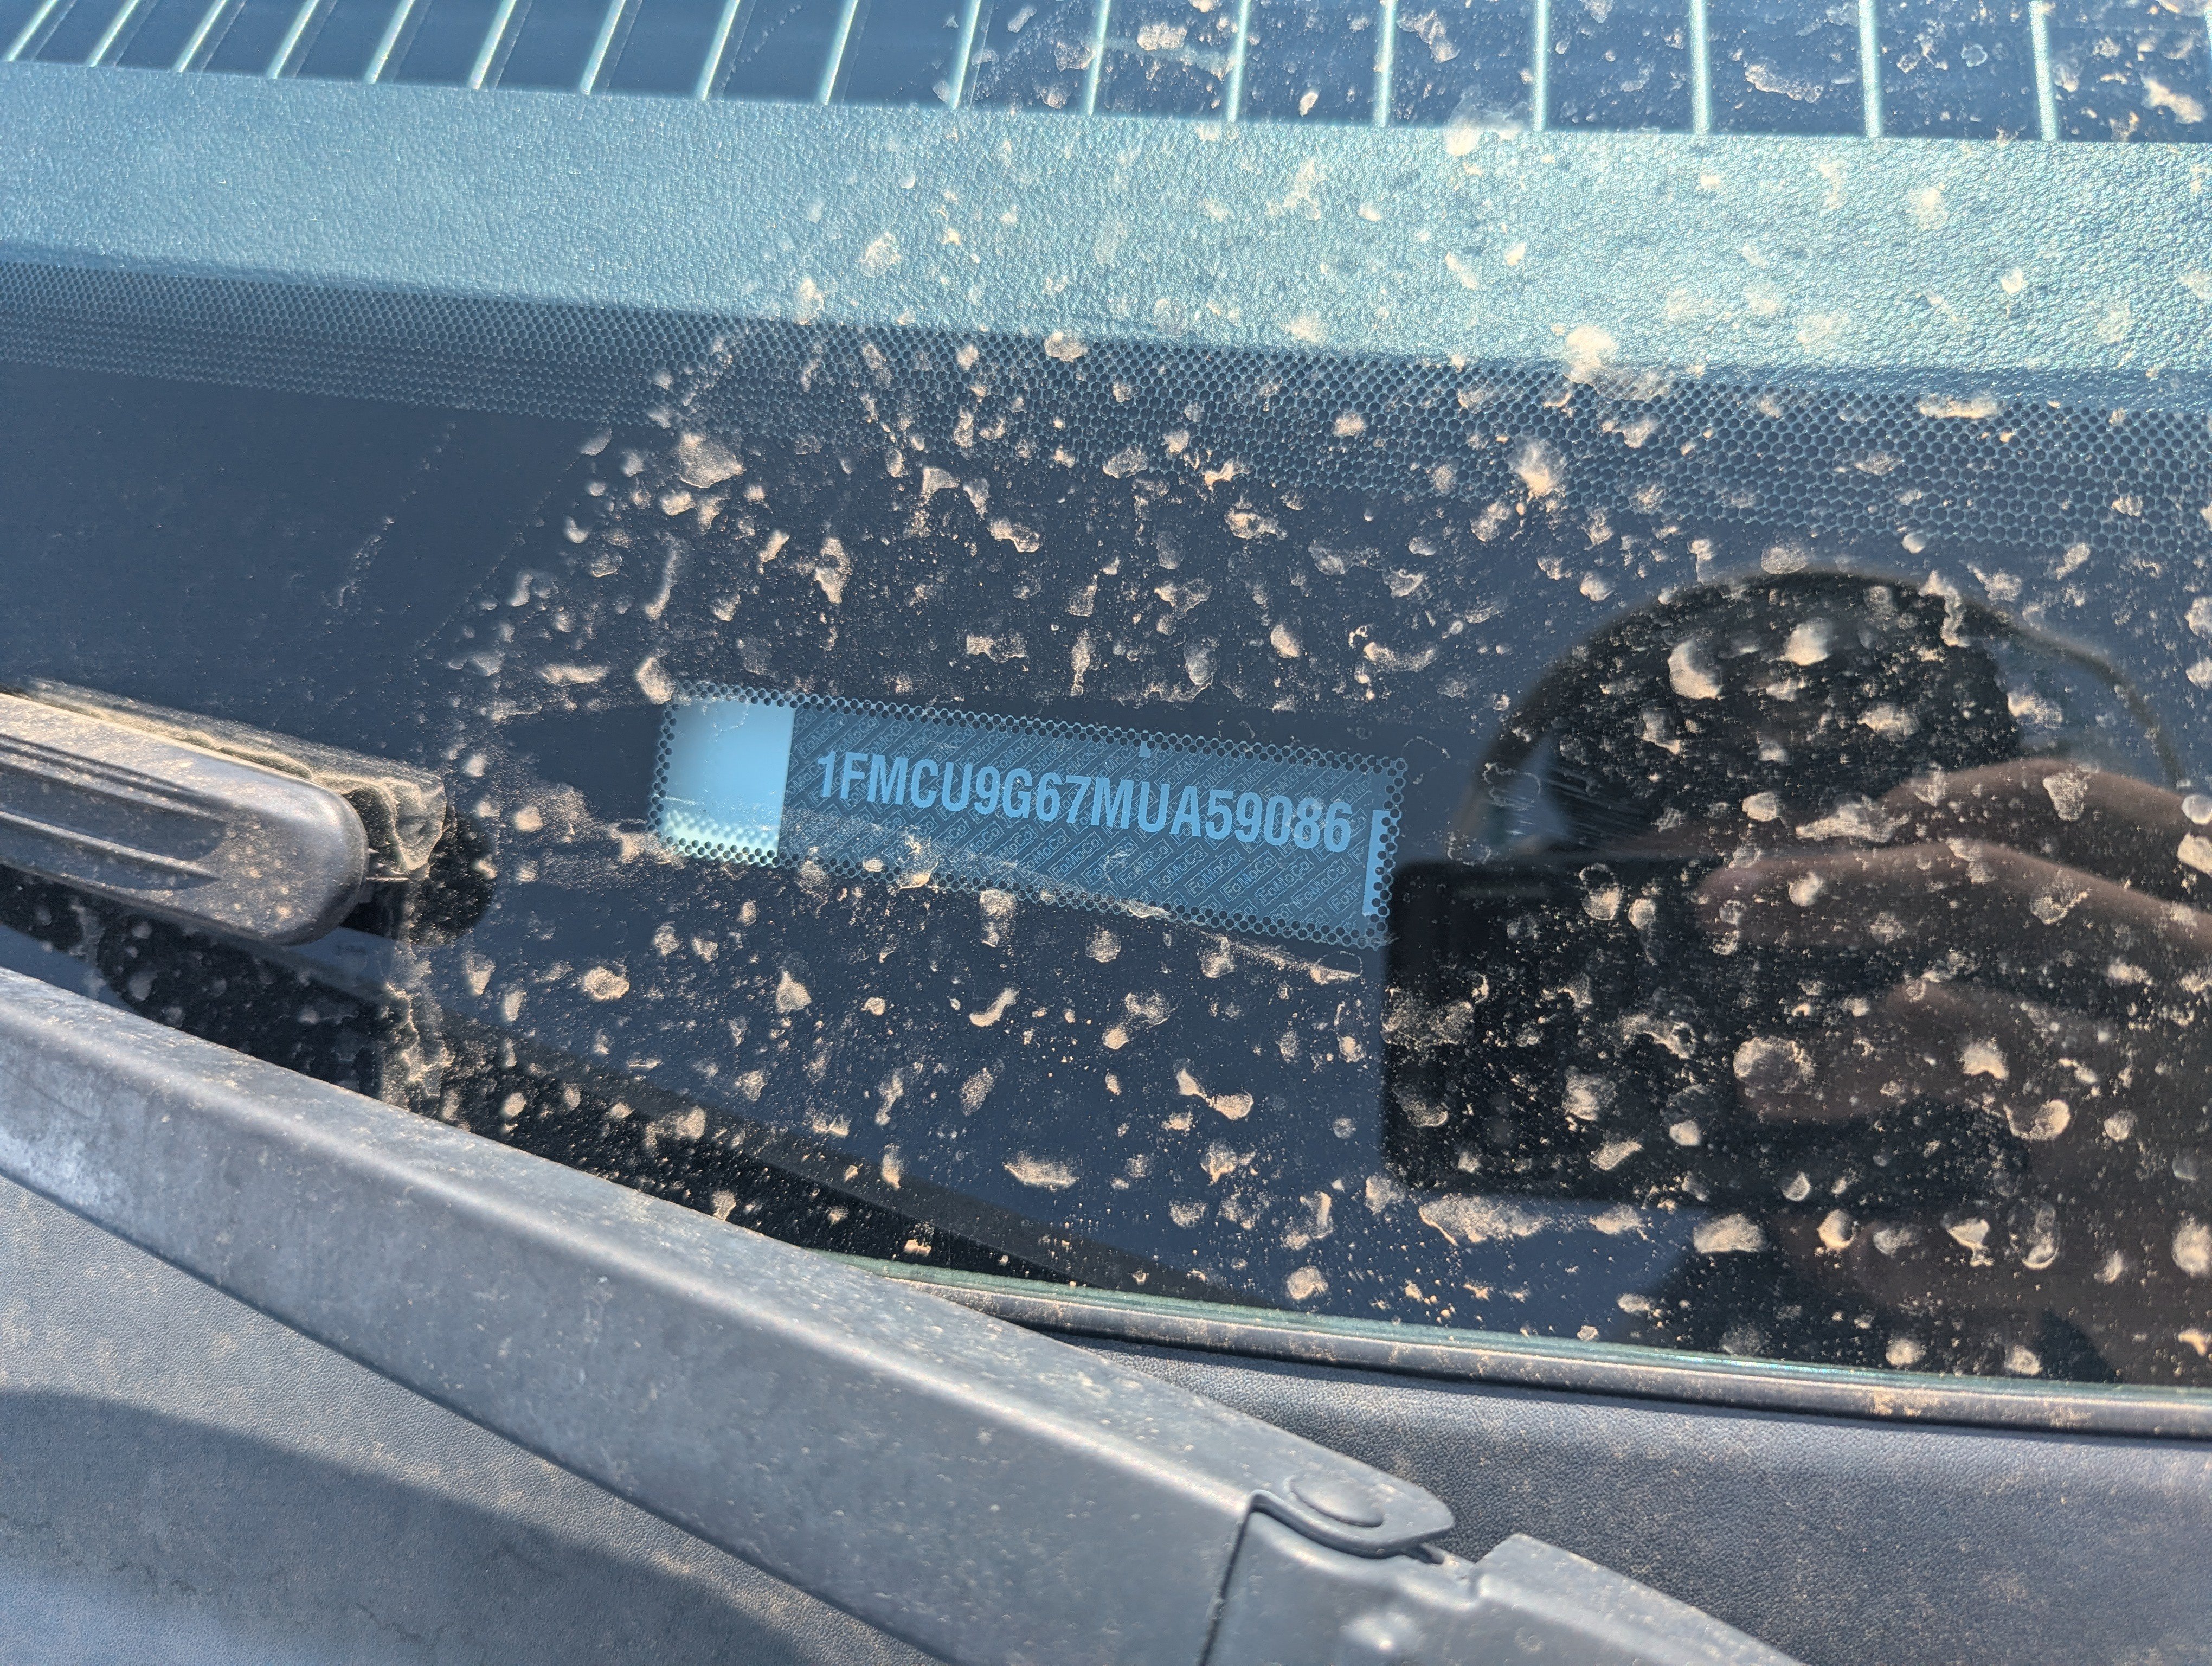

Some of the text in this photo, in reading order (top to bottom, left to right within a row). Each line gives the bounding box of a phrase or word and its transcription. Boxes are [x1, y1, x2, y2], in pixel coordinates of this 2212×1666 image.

[799, 715, 844, 755] FoMoCo
[818, 751, 1353, 853] 1FMCU9G67MUA59086
[1019, 835, 1066, 875] FoMoCo
[1052, 838, 1100, 878] FoMoCo
[1119, 846, 1168, 886] FoMoCo
[1153, 850, 1203, 890] FoMoCo
[1188, 853, 1238, 894] FoMoCo
[1223, 857, 1274, 898] FoMoCo
[1258, 861, 1309, 902] FoMoCo
[1294, 865, 1346, 906] FoMoCo
